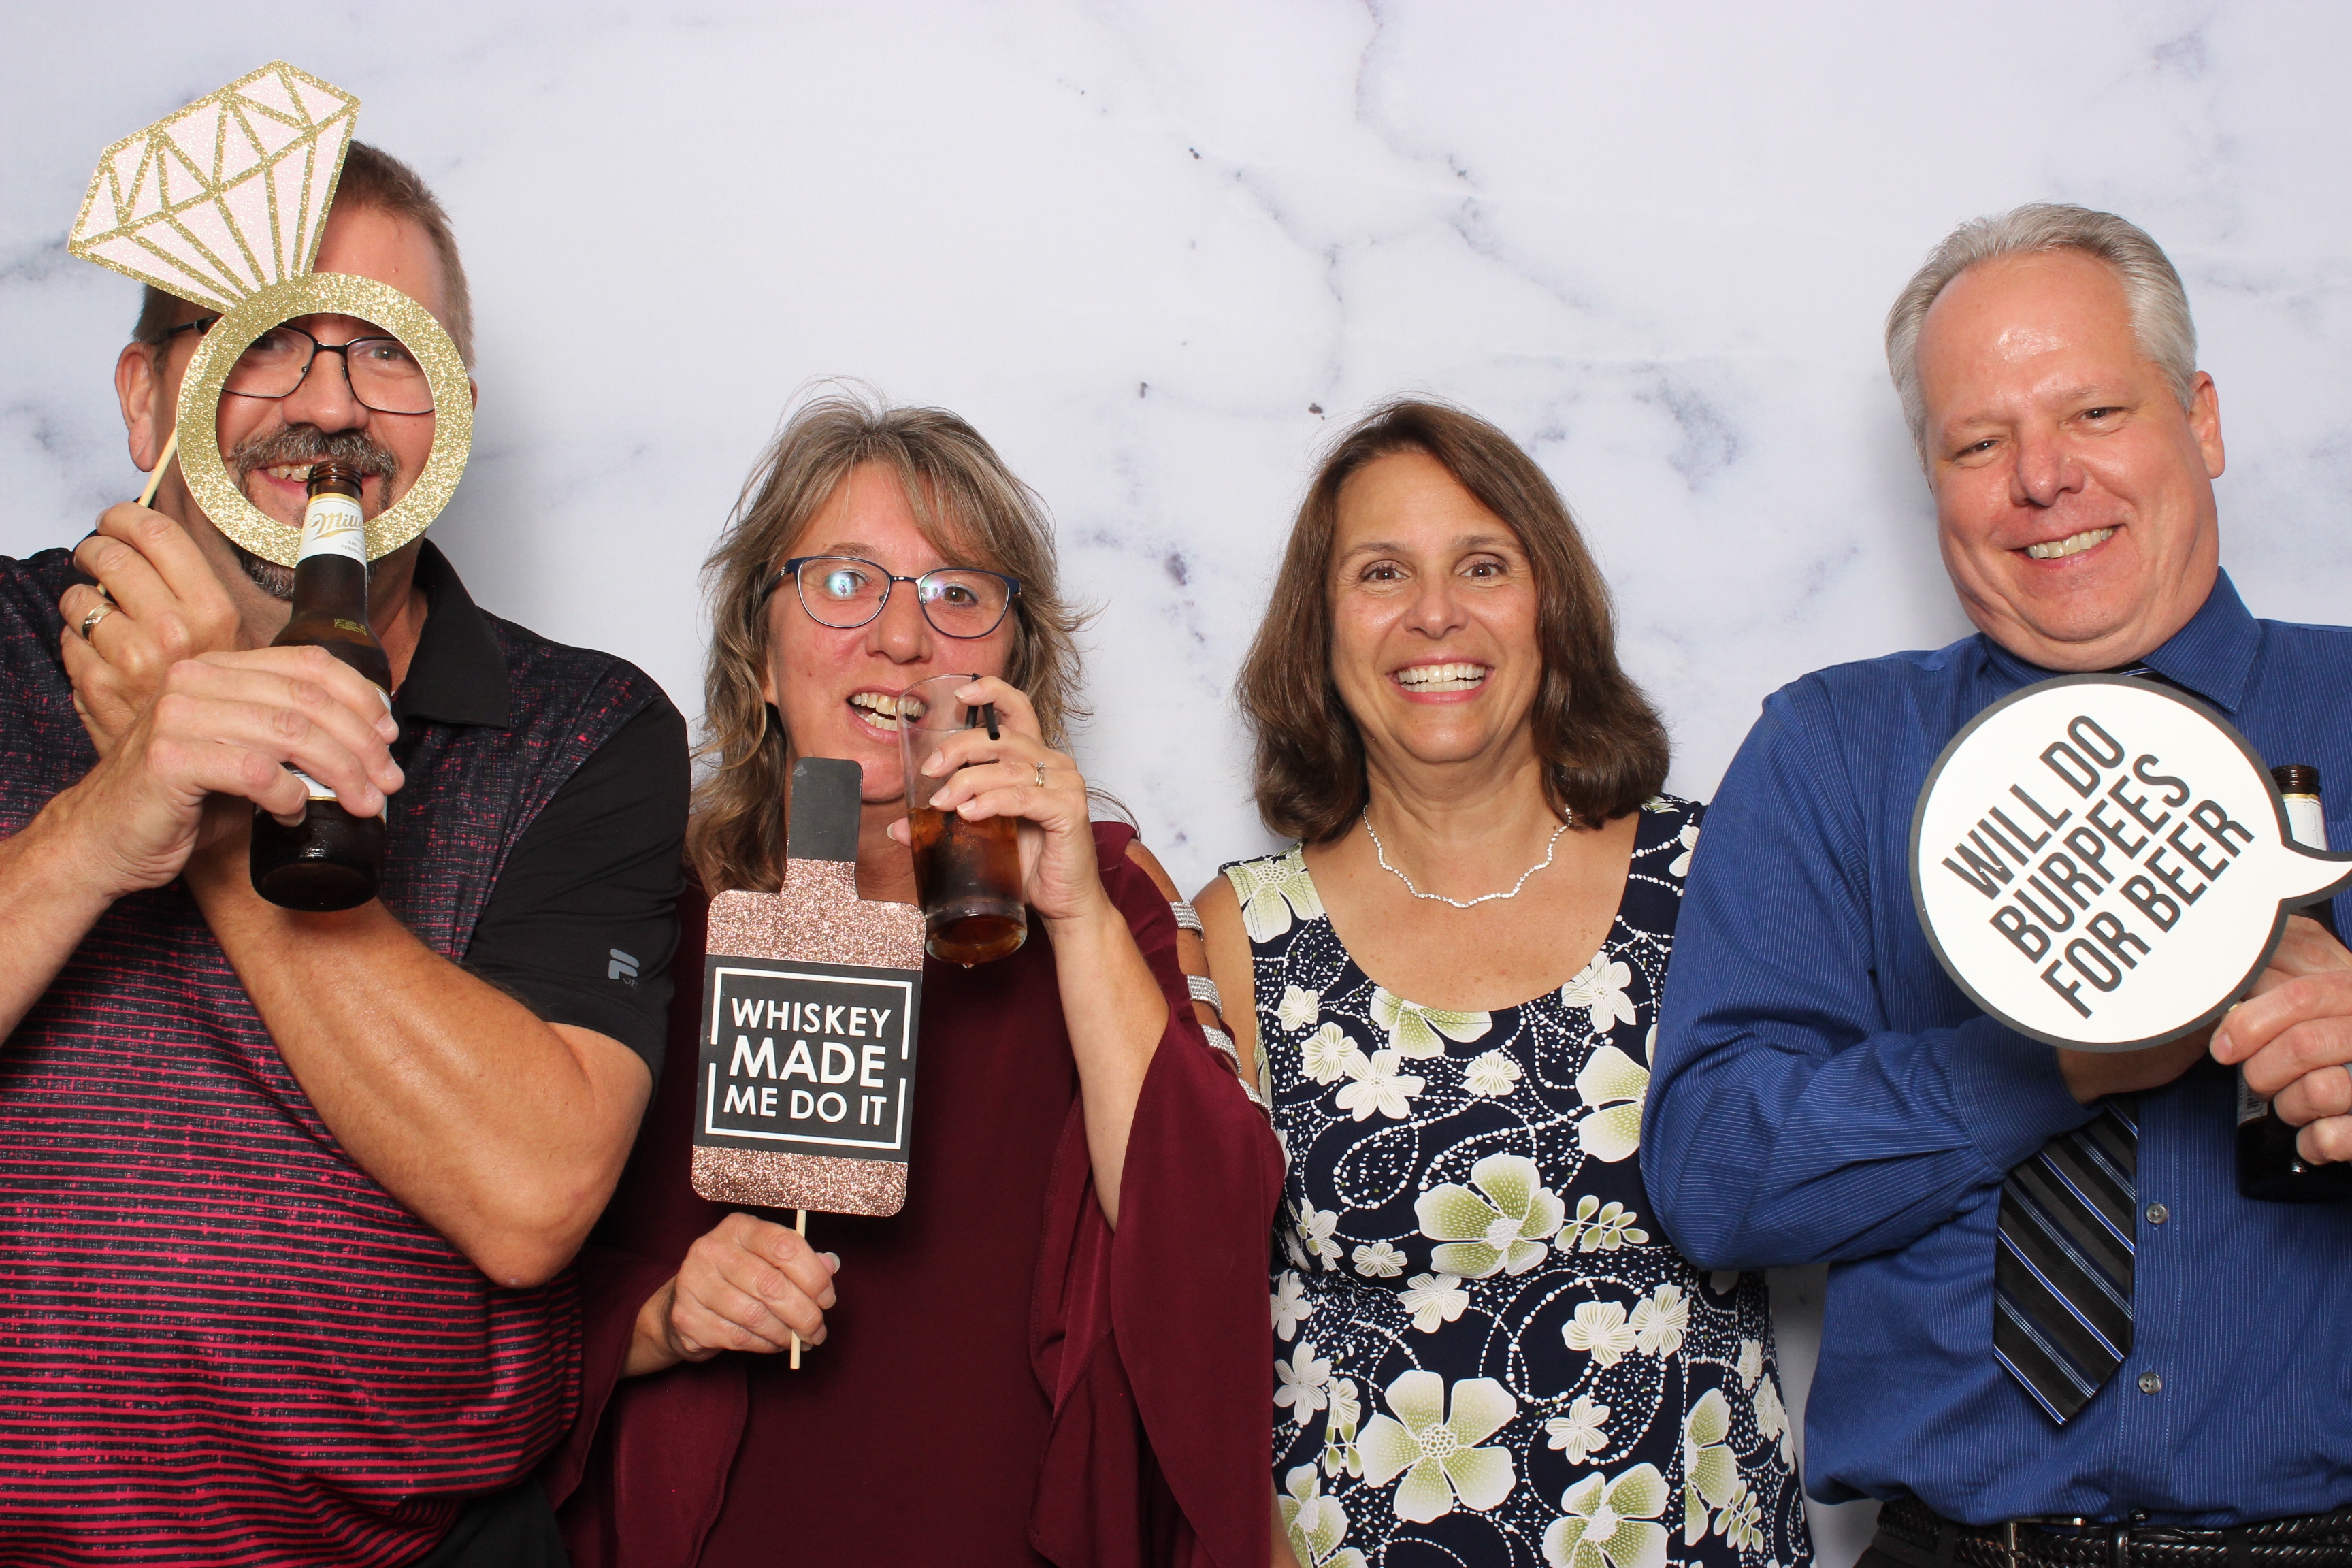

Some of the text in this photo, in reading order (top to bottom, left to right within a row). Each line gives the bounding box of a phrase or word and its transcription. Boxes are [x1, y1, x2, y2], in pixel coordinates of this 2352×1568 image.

[308, 512, 363, 536] Mille
[1942, 715, 2125, 900] WILL DO
[1989, 753, 2191, 964] BURPEES
[2040, 799, 2255, 1019] FOR BEER
[731, 997, 892, 1039] WHISKEY
[728, 1034, 886, 1089] MADE
[723, 1084, 887, 1126] ME DO IT
